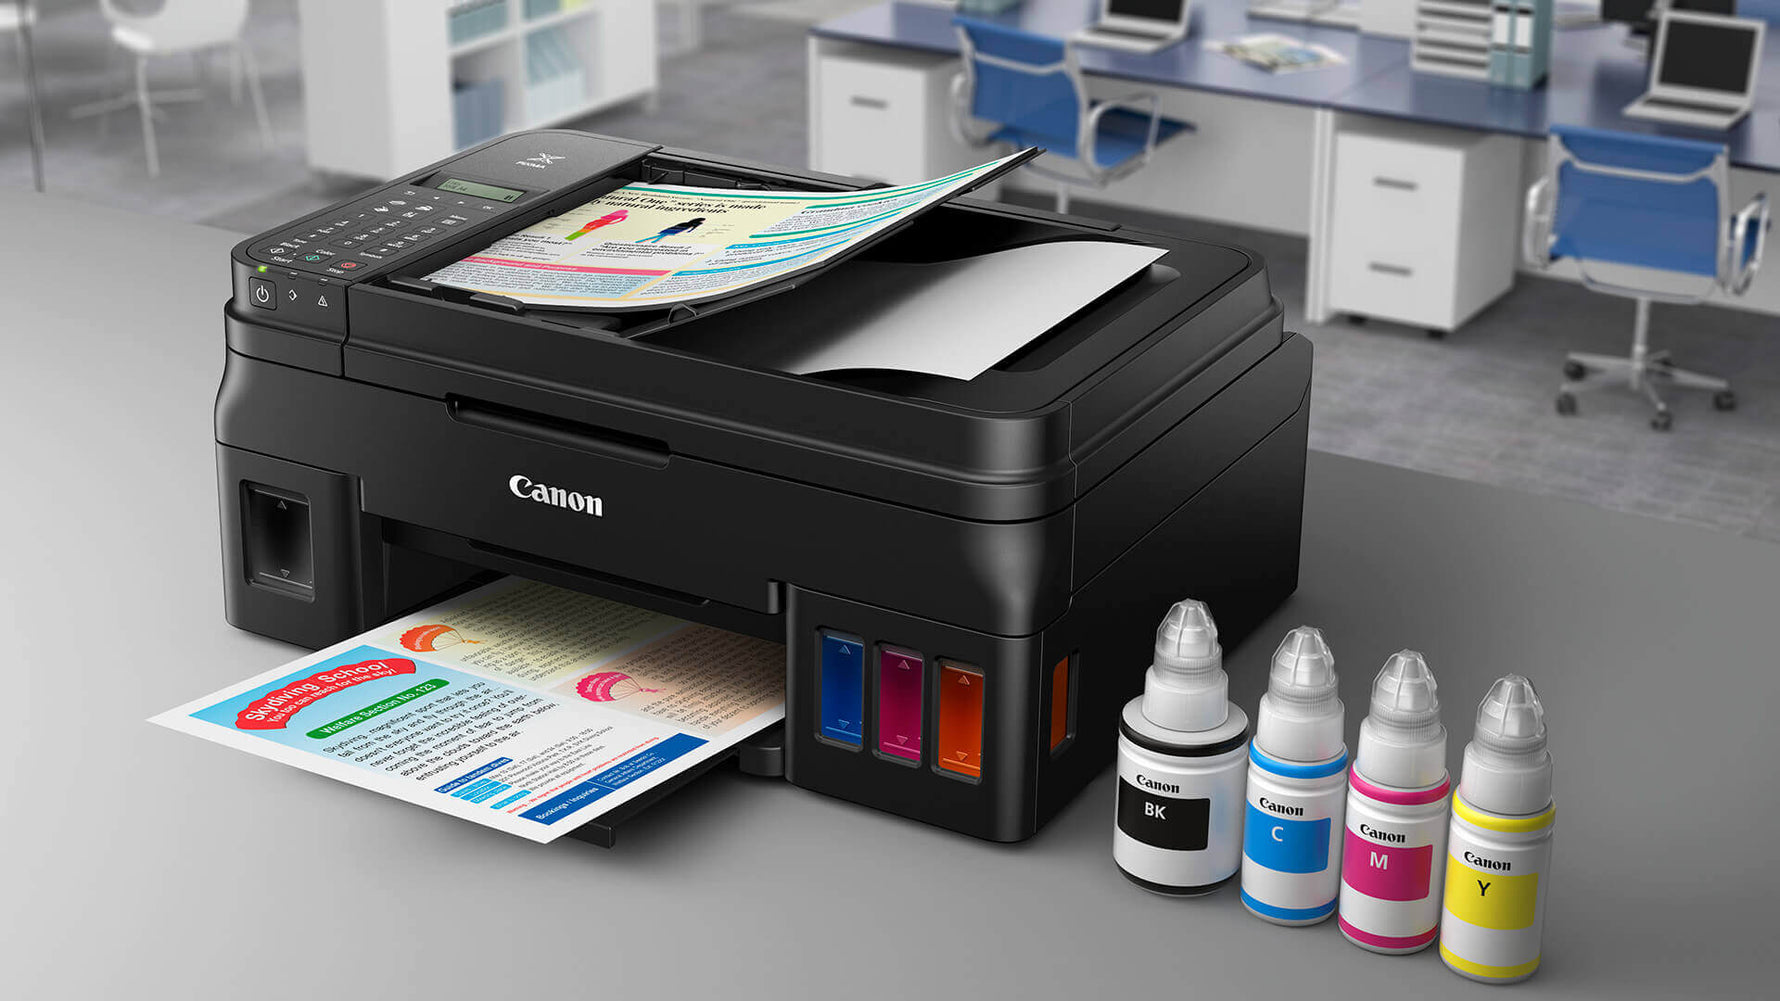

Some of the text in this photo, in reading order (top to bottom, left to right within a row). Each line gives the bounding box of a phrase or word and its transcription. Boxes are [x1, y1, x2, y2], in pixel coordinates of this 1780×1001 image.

[509, 474, 603, 517] Canon
[246, 662, 387, 720] Skydiving School
[267, 713, 285, 722] You
[277, 705, 297, 713] too
[292, 696, 315, 706] can
[307, 684, 339, 697] reach
[372, 667, 396, 679] sky!
[415, 703, 437, 713] sport
[469, 682, 485, 690] you
[320, 717, 362, 733] Welfare
[360, 700, 400, 717] Section
[416, 684, 436, 692] 123
[385, 731, 423, 748] everyone
[422, 722, 444, 731] want
[469, 699, 491, 710] once?
[353, 742, 376, 751] from
[408, 719, 425, 727] and
[435, 701, 467, 714] through
[370, 755, 394, 767] never
[393, 743, 420, 755] forget
[435, 720, 473, 737] incredible
[470, 708, 501, 720] feeling
[385, 757, 418, 771] coming
[433, 734, 466, 749] moment
[474, 721, 493, 729] fear
[504, 707, 524, 718] jump
[522, 698, 543, 707] from
[401, 764, 428, 776] above
[443, 744, 471, 756] clouds
[469, 730, 498, 743] toward
[512, 714, 533, 724] earth
[416, 761, 459, 780] entrusting
[456, 746, 487, 762] yourself
[1136, 774, 1180, 794] Canon
[536, 803, 568, 819] Bookings
[569, 788, 598, 802] Inquiries
[1145, 801, 1167, 820] BK
[1260, 797, 1304, 817] Canon
[1271, 826, 1284, 842] C
[1360, 824, 1406, 843] Canon
[1370, 851, 1388, 870] M
[1464, 851, 1512, 871] Canon
[1477, 880, 1491, 896] Y
